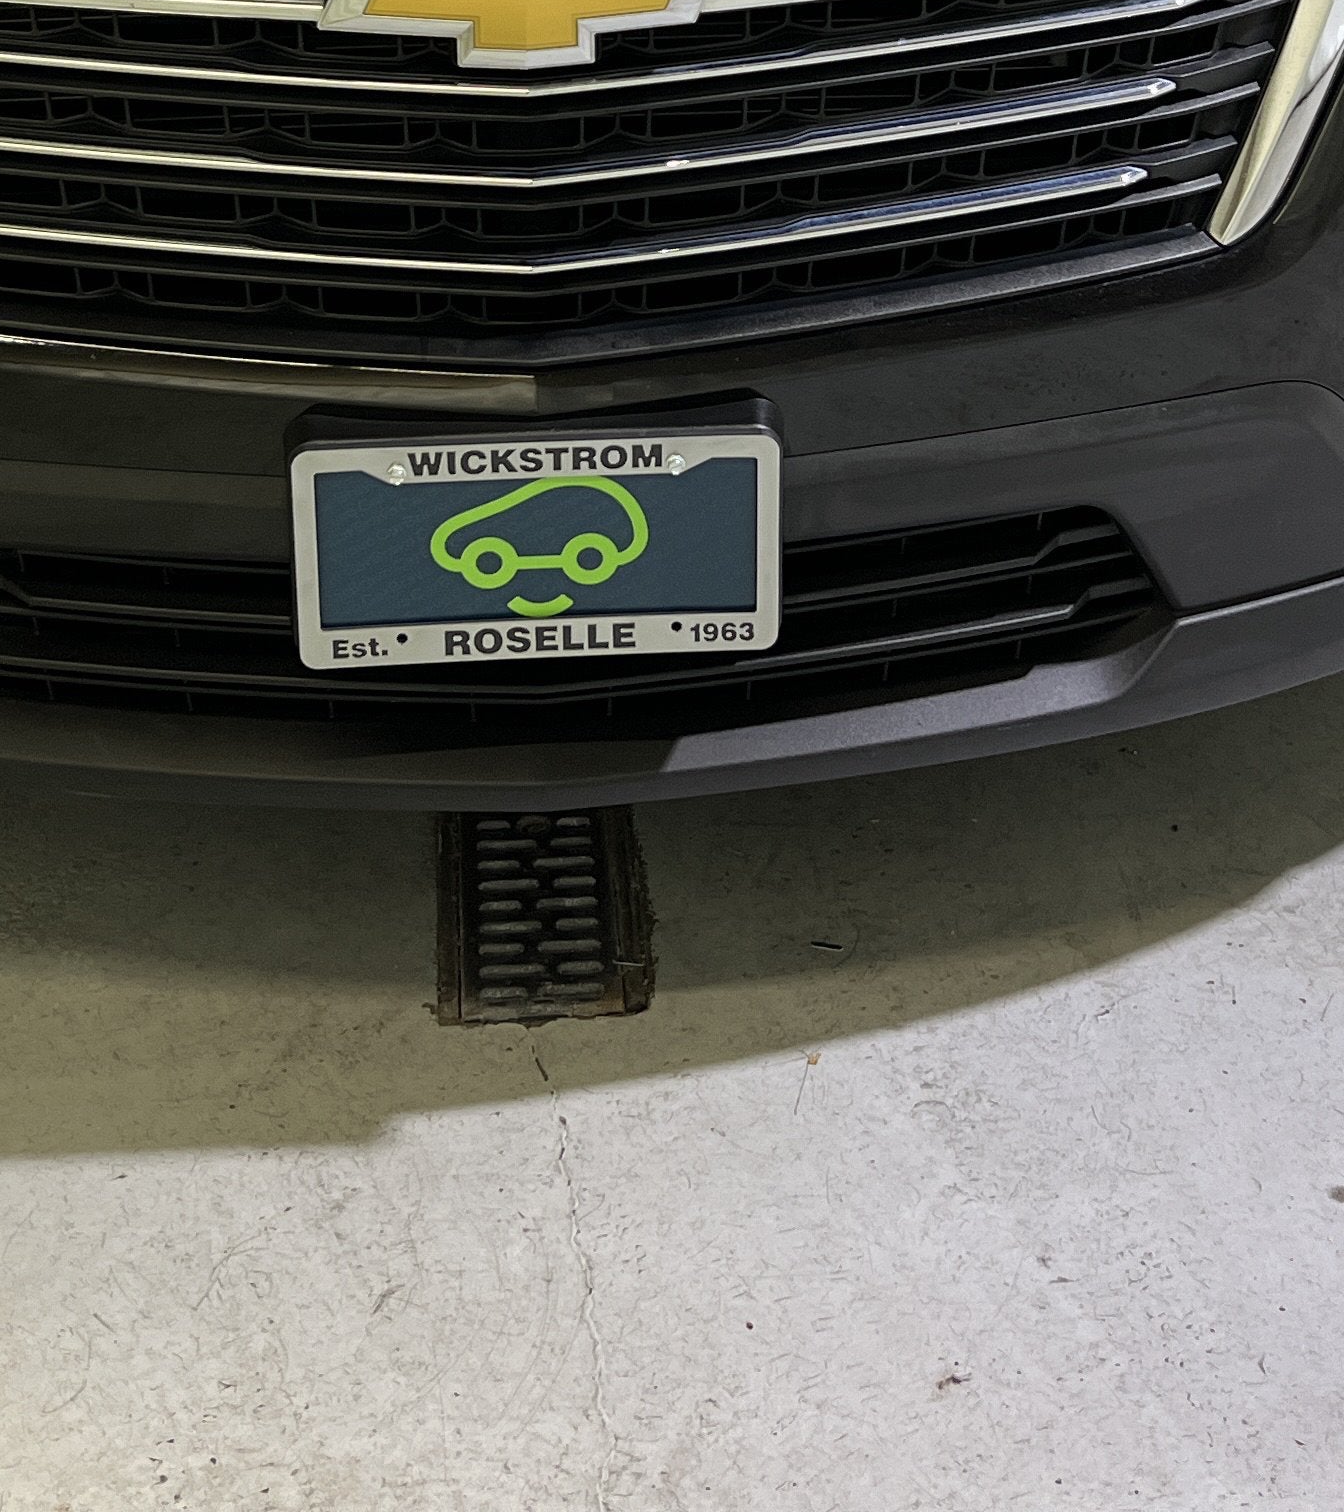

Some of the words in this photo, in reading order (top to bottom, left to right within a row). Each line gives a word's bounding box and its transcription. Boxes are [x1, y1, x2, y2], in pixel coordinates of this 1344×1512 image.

[407, 444, 663, 477] WICKSTROM
[332, 638, 388, 659] Est.
[444, 622, 636, 656] ROSELLE
[690, 622, 756, 642] 1963
